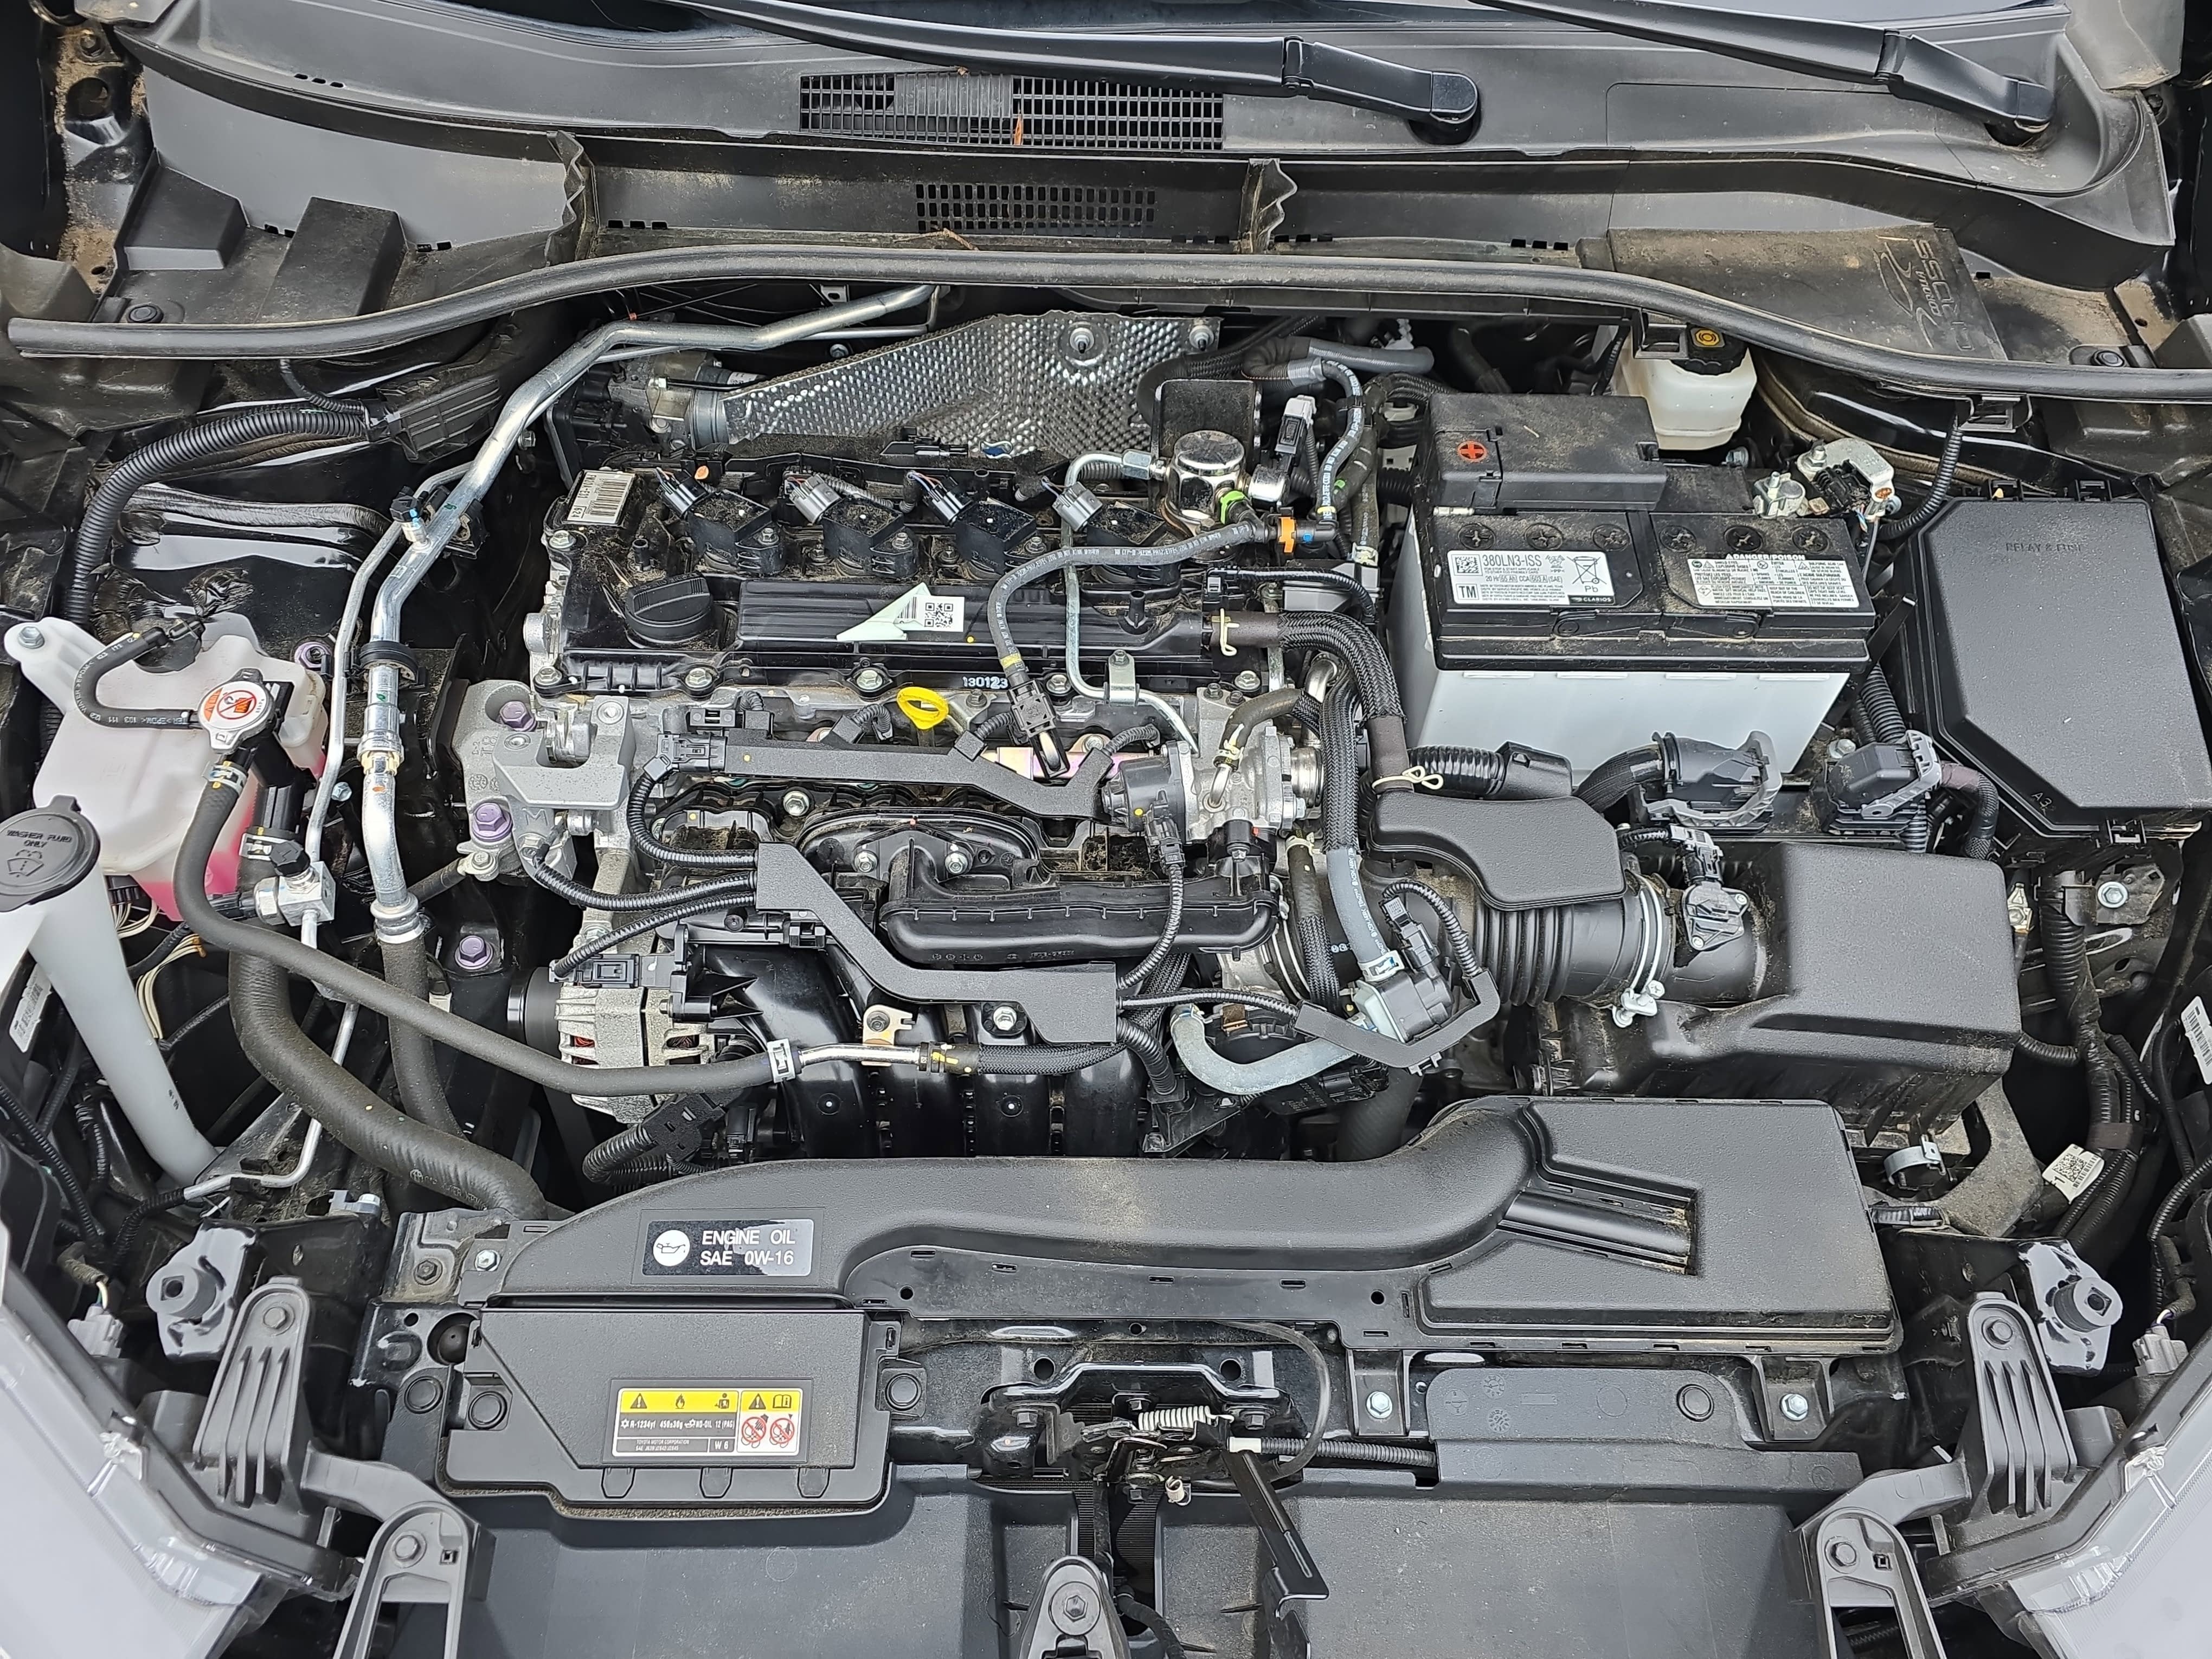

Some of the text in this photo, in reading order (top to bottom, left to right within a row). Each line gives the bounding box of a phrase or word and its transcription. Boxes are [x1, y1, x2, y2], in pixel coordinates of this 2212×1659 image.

[1482, 555, 1542, 567] 380LN3-ISS
[1459, 586, 1476, 598] TM
[962, 676, 1008, 690] 130123
[74, 689, 87, 714] WATER
[7, 829, 72, 843] WASHER FLUID
[24, 840, 48, 848] ONLY
[702, 1229, 796, 1245] ENGINE OIL
[700, 1250, 794, 1266] SAE 0W-16
[715, 1420, 722, 1429] 12
[715, 1441, 722, 1449] W
